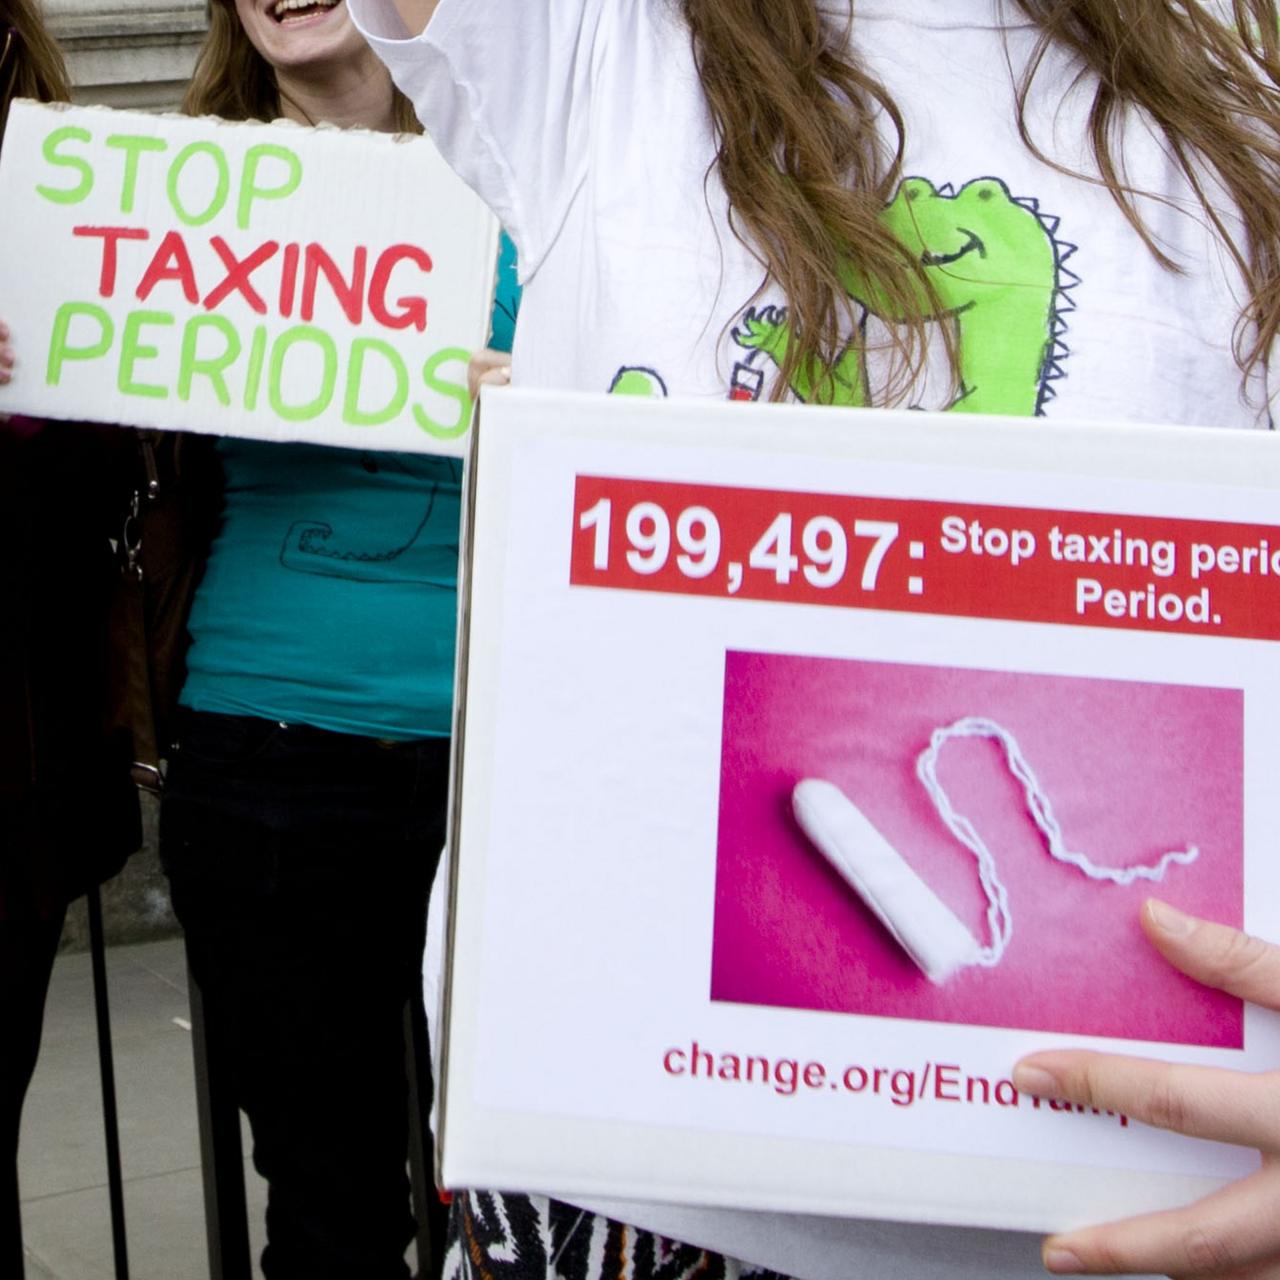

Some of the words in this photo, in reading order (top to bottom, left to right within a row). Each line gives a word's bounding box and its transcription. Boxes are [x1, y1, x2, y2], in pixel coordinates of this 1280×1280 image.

[36, 125, 303, 230] STOP
[72, 226, 433, 332] TAXING
[45, 301, 473, 440] PERIODS
[578, 497, 925, 595] 199,497:
[939, 515, 1037, 565] Stop
[1049, 529, 1177, 578] taxing
[1075, 577, 1224, 626] Period.
